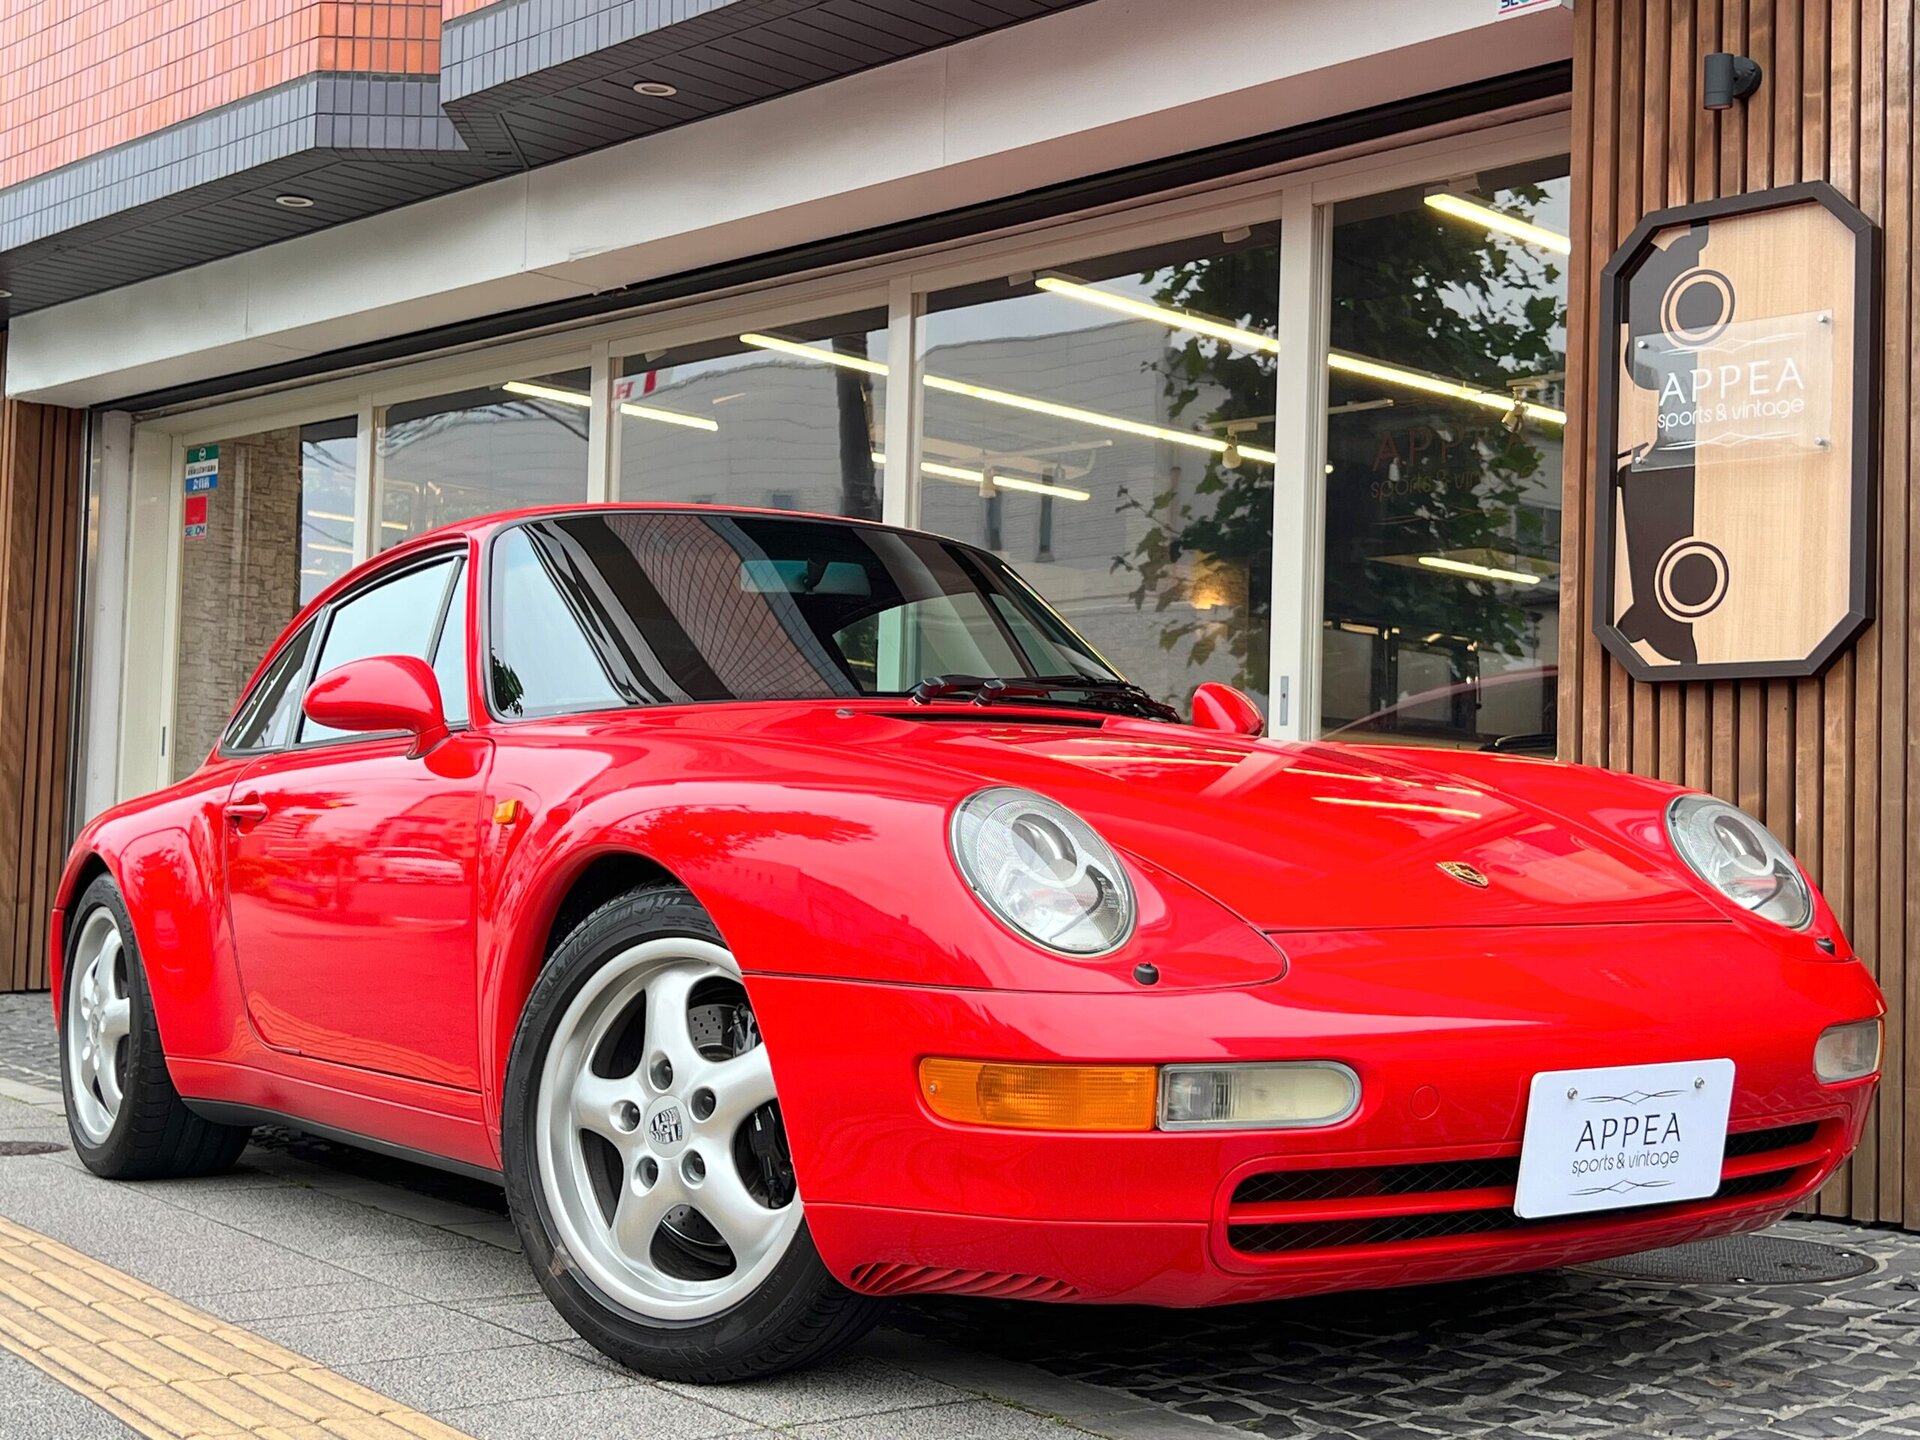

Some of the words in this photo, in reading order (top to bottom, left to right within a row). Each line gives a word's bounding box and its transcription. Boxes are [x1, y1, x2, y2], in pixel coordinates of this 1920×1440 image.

[1659, 357, 1804, 406] APPEA
[1657, 404, 1712, 432] sports
[1716, 402, 1728, 421] &
[1732, 398, 1804, 421] vintage
[1575, 1112, 1681, 1152] APPEA
[1571, 1154, 1615, 1177] sports
[1616, 1152, 1626, 1170] &
[1628, 1149, 1680, 1169] vintage
